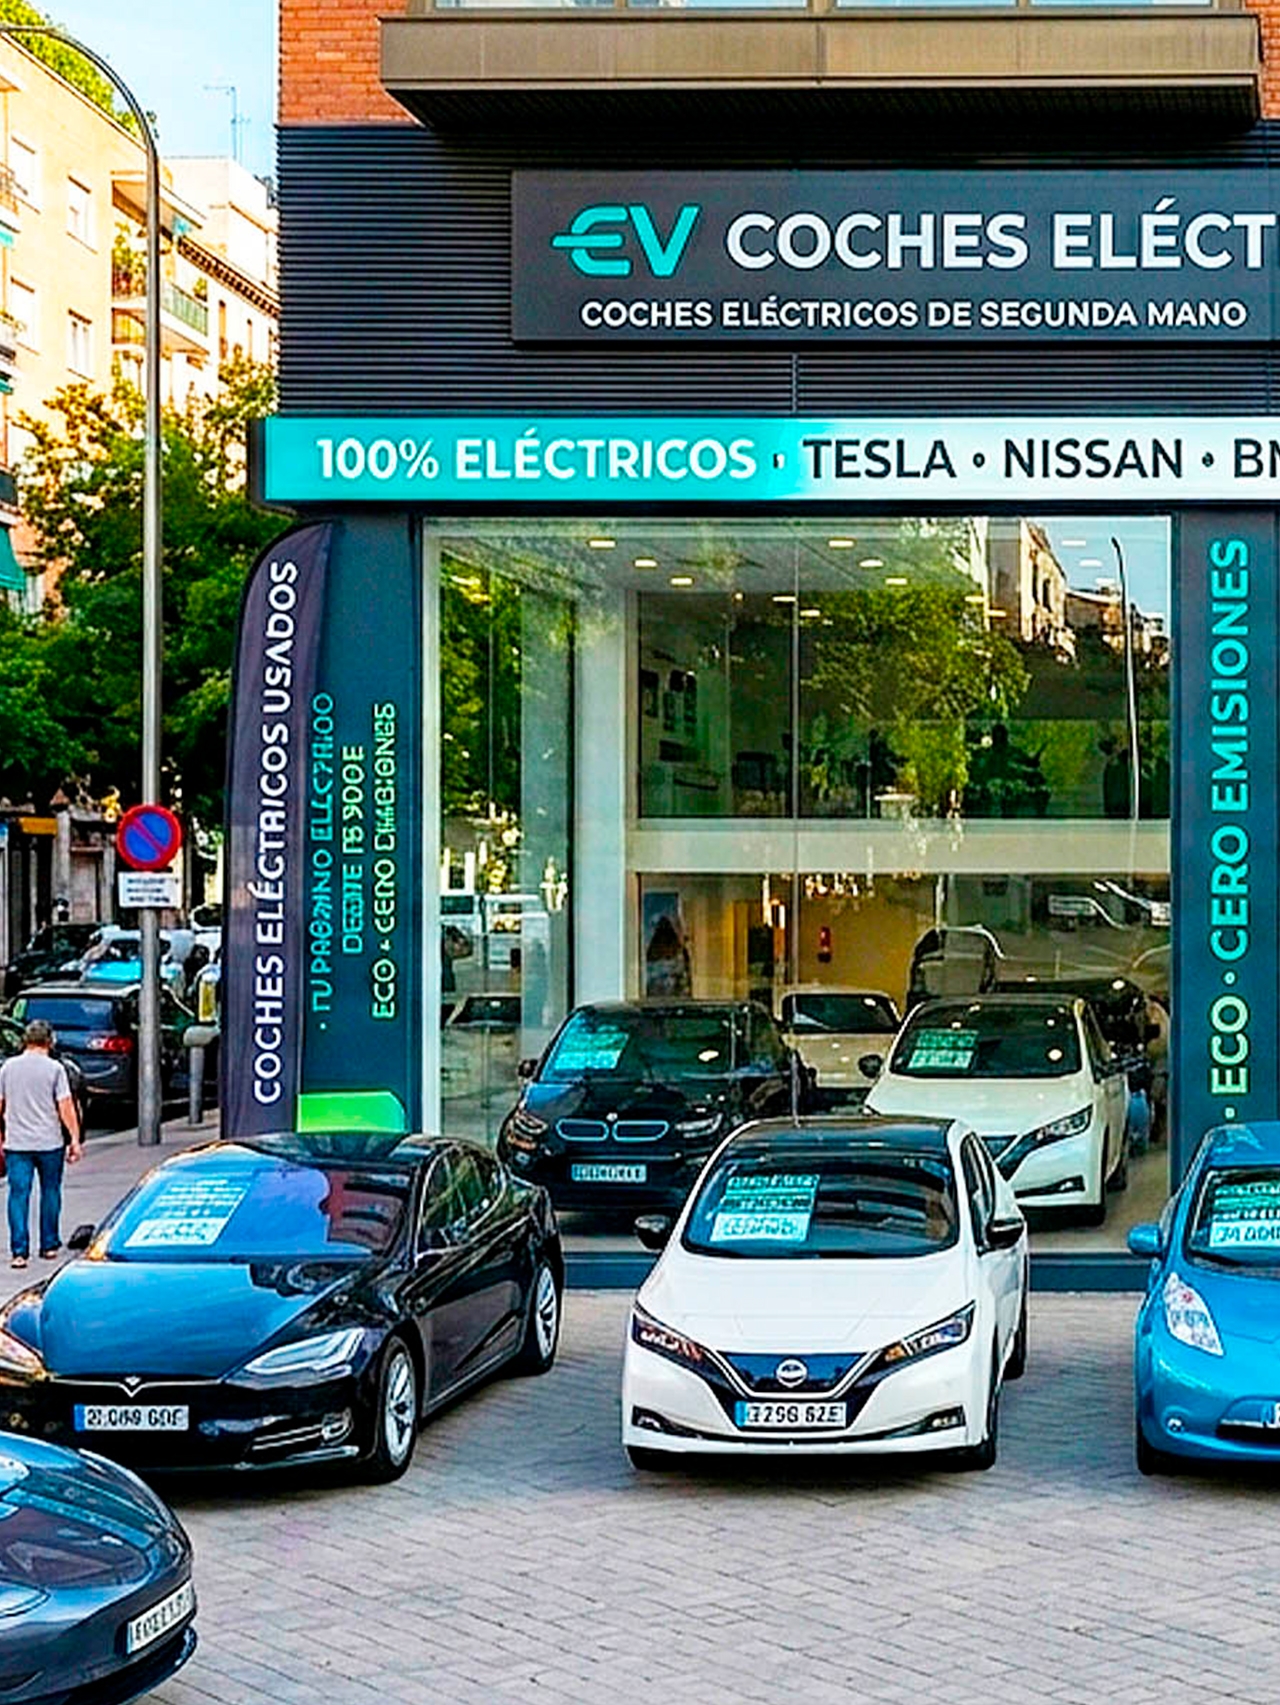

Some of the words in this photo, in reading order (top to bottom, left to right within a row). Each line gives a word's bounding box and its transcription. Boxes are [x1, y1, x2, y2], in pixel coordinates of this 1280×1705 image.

[552, 206, 699, 276] EV
[727, 212, 1028, 269] COCHES
[581, 301, 713, 327] COCHES
[722, 295, 919, 327] ELÉCTRICOS
[928, 301, 972, 327] DE
[980, 301, 1138, 327] SEGUNDA
[1147, 301, 1247, 327] MANO
[316, 437, 439, 479] 100%
[456, 427, 757, 479] ELÉCTRICOS
[802, 438, 957, 479] TESLA
[1004, 438, 1183, 479] NISSAN
[262, 562, 298, 713] USADOS
[1210, 539, 1249, 811] EMISIONES
[1210, 825, 1248, 961] CERO
[254, 956, 284, 1105] COCHES
[1210, 995, 1248, 1094] ECO
